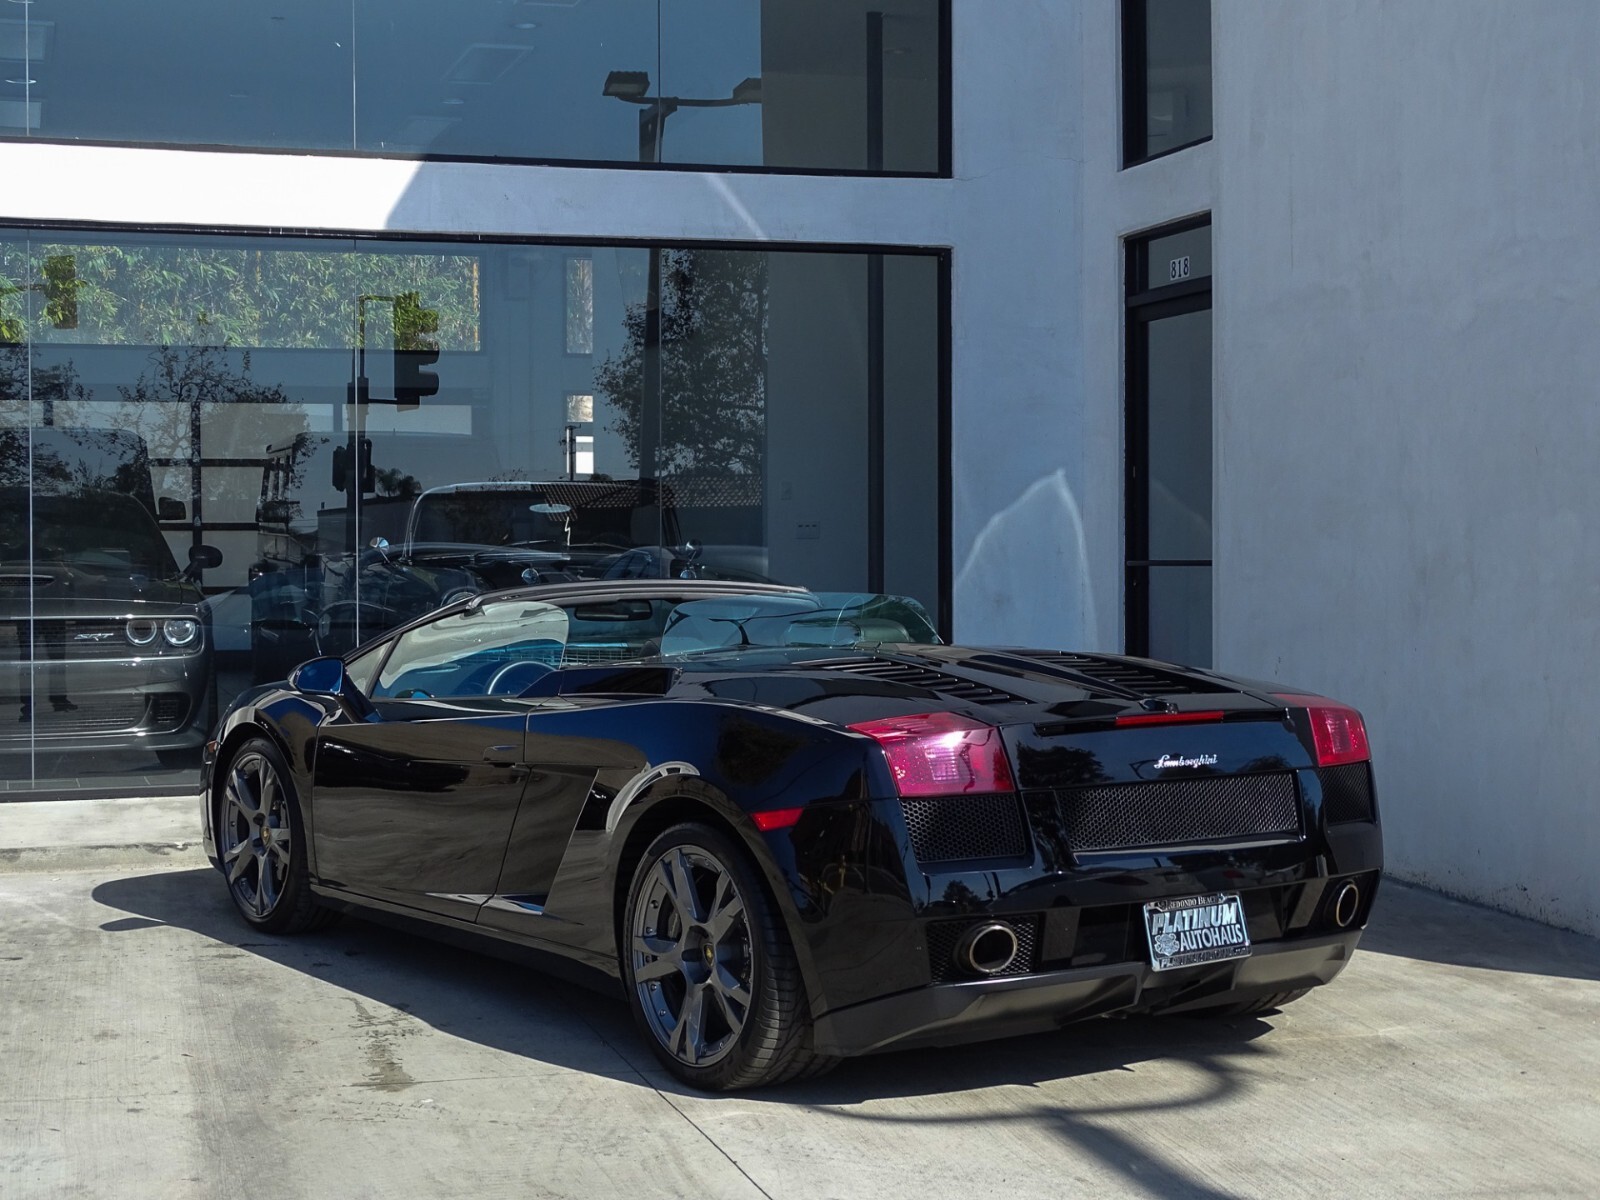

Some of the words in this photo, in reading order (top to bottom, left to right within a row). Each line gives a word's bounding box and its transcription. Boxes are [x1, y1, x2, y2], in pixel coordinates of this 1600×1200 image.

[1171, 257, 1189, 279] 818
[1153, 753, 1218, 769] Lamborghini
[1152, 903, 1237, 935] PLATINUM
[1180, 924, 1243, 951] AUTOHAUS
